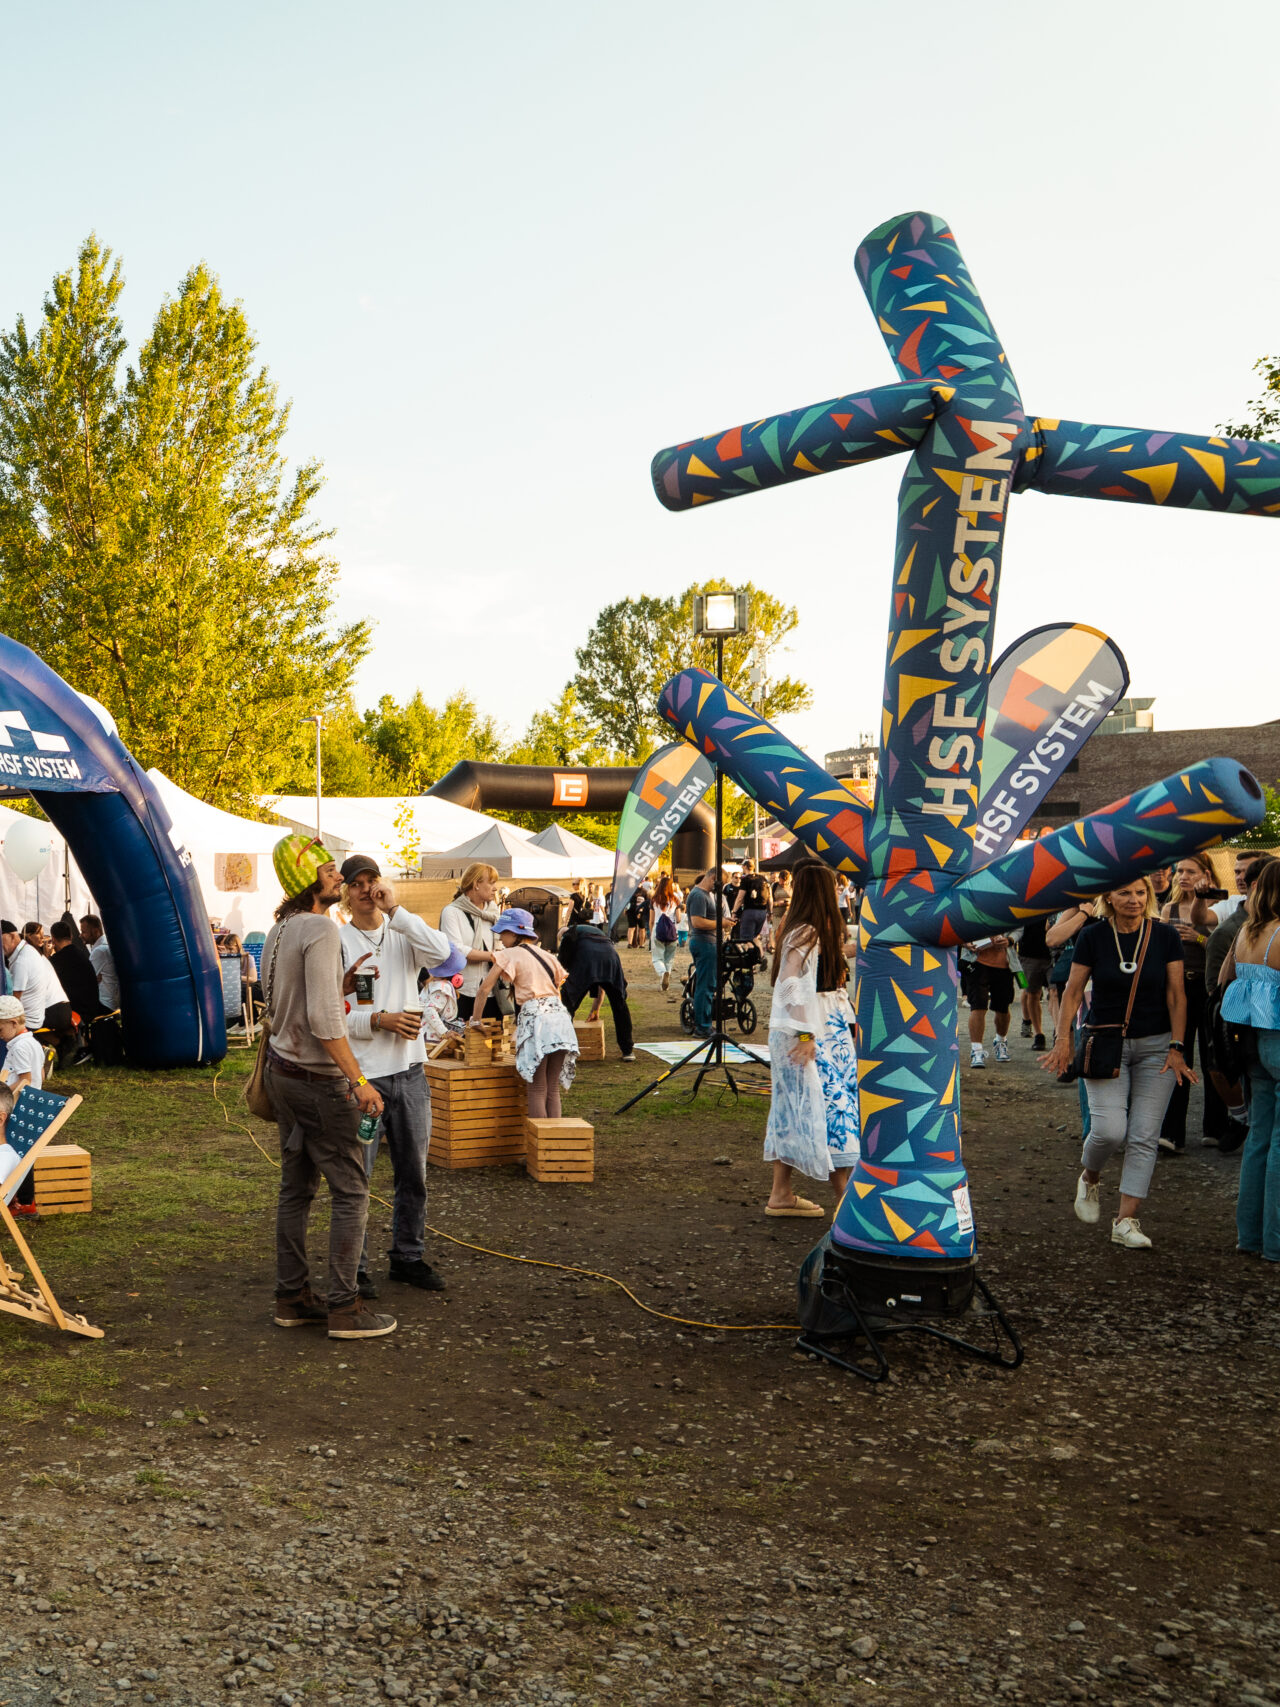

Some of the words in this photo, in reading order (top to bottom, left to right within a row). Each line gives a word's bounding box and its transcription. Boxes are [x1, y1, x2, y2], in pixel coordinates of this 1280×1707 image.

[939, 420, 1019, 675] SYSTEM
[23, 756, 82, 780] SYSTEM
[921, 692, 979, 817] HSF
[974, 789, 1021, 855] HSF
[1009, 679, 1115, 796] SYSTEM
[626, 841, 656, 881] HSF
[649, 776, 708, 846] SYSTEM
